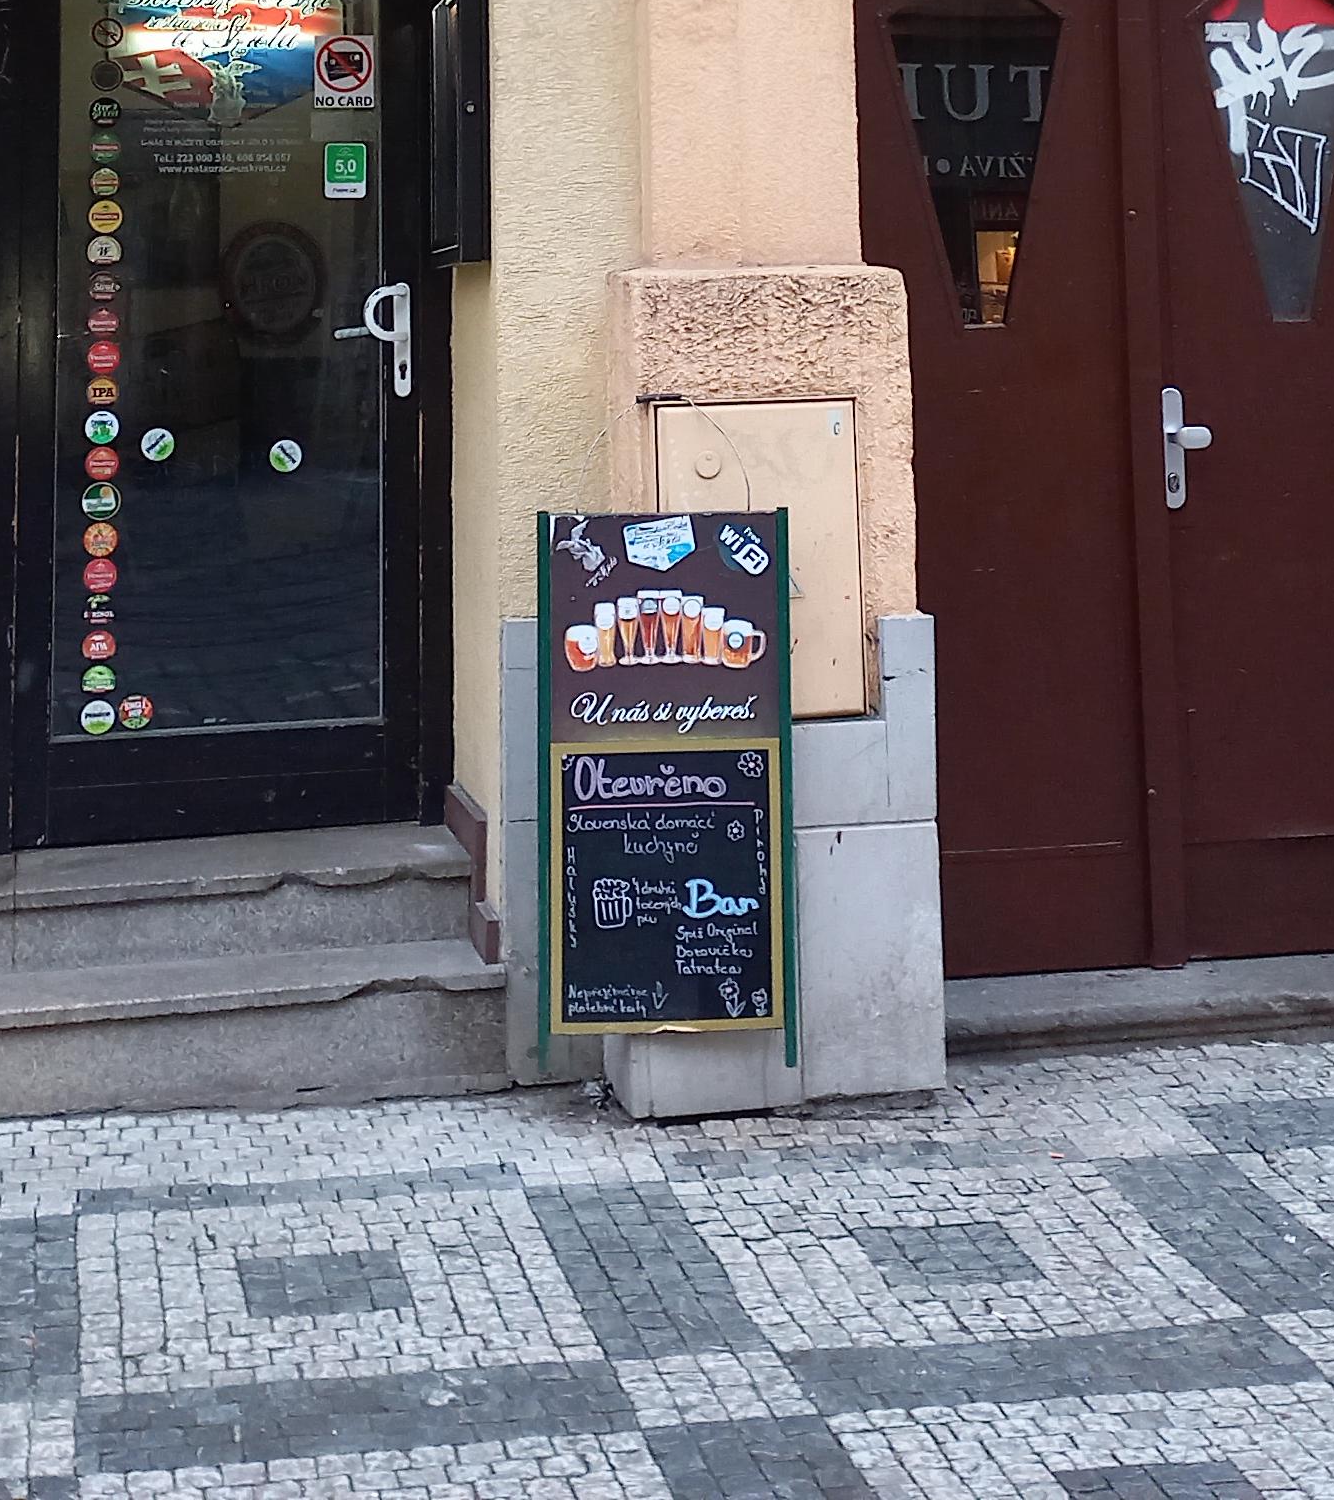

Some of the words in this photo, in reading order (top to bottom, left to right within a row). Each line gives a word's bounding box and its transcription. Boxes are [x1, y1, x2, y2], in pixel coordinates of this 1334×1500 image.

[315, 96, 335, 107] NO
[337, 96, 373, 107] CARD
[335, 159, 357, 175] 5,0
[92, 387, 114, 398] IPA
[743, 526, 761, 545] Free
[570, 691, 614, 726] U
[611, 700, 651, 723] nás
[652, 702, 673, 723] si
[675, 695, 758, 734] vybereš.
[574, 756, 727, 801] Otevřeno
[567, 812, 652, 832] Slovenská
[682, 878, 760, 919] Bar
